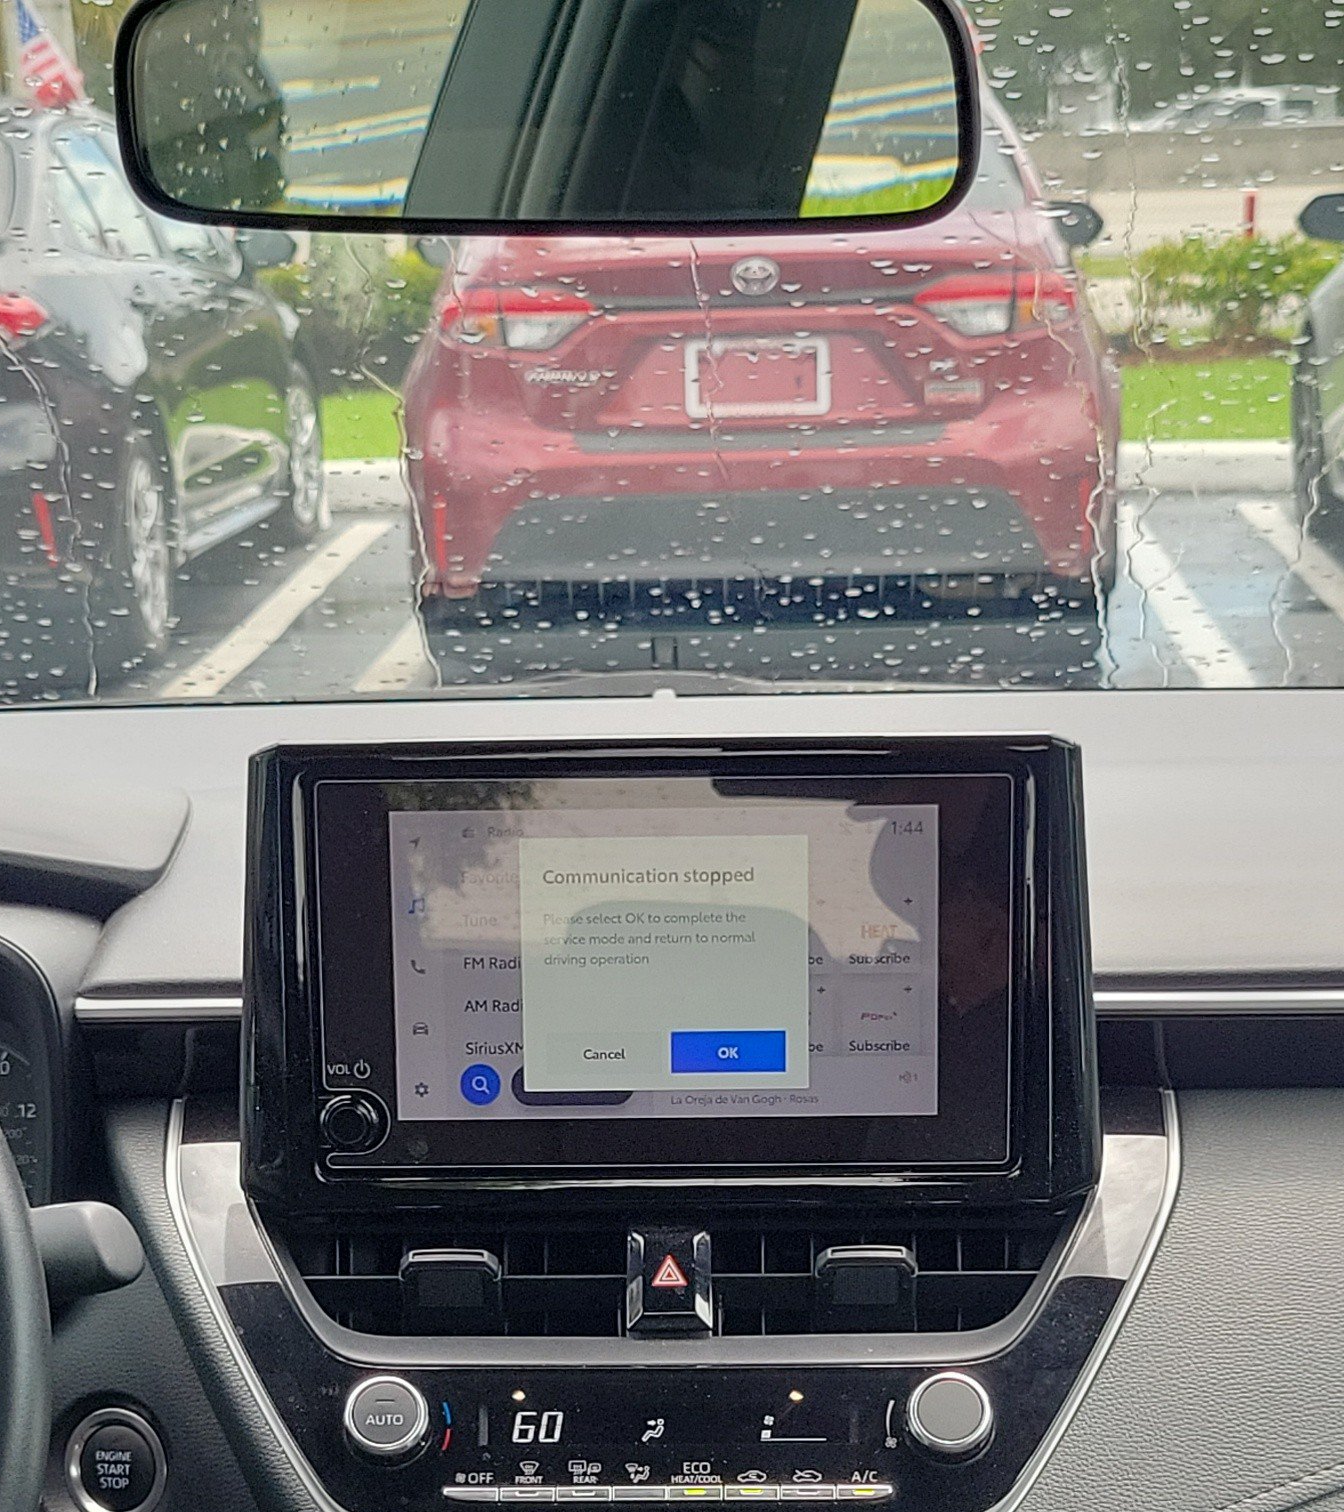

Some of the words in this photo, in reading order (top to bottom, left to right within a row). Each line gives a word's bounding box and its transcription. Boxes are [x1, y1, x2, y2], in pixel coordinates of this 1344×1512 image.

[487, 827, 524, 839] Radio
[891, 821, 923, 835] 1:44
[460, 870, 520, 884] Favorite
[543, 868, 678, 884] Communication
[684, 867, 755, 886] stopped
[463, 914, 498, 927] Tune
[544, 913, 583, 925] Please
[586, 913, 622, 924] select
[625, 913, 645, 924] OK
[648, 913, 661, 924] to
[663, 912, 723, 928] complete
[726, 912, 746, 923] the
[544, 934, 586, 945] service
[589, 932, 625, 945] mode
[628, 932, 651, 945] and
[655, 933, 692, 944] return
[695, 932, 709, 944] to
[712, 931, 756, 943] normal
[463, 957, 485, 969] FM
[489, 956, 521, 970] Radi
[544, 954, 587, 967] driving
[590, 953, 650, 967] operation
[849, 953, 911, 965] Subscribe
[464, 1001, 487, 1012] AM
[465, 1042, 524, 1055] SiriusXM
[849, 1040, 911, 1051] Subscribe
[583, 1049, 626, 1060] Cancel
[717, 1047, 739, 1059] OK
[327, 1064, 350, 1075] VOL
[671, 1095, 682, 1104] La
[716, 1095, 728, 1104] de
[731, 1095, 750, 1103] Van
[753, 1094, 782, 1106] Gogh
[17, 1103, 37, 1118] 12
[365, 1413, 404, 1426] AUTO
[512, 1411, 564, 1443] 60
[96, 1451, 132, 1461] ENGINE
[97, 1463, 131, 1475] START
[683, 1462, 711, 1474] ECO
[467, 1472, 494, 1484] OFF
[515, 1475, 543, 1484] FRONT
[573, 1475, 597, 1484] REAR
[671, 1474, 723, 1484] HEAT/COOL
[851, 1470, 878, 1483] A/C
[99, 1477, 129, 1489] STOP
